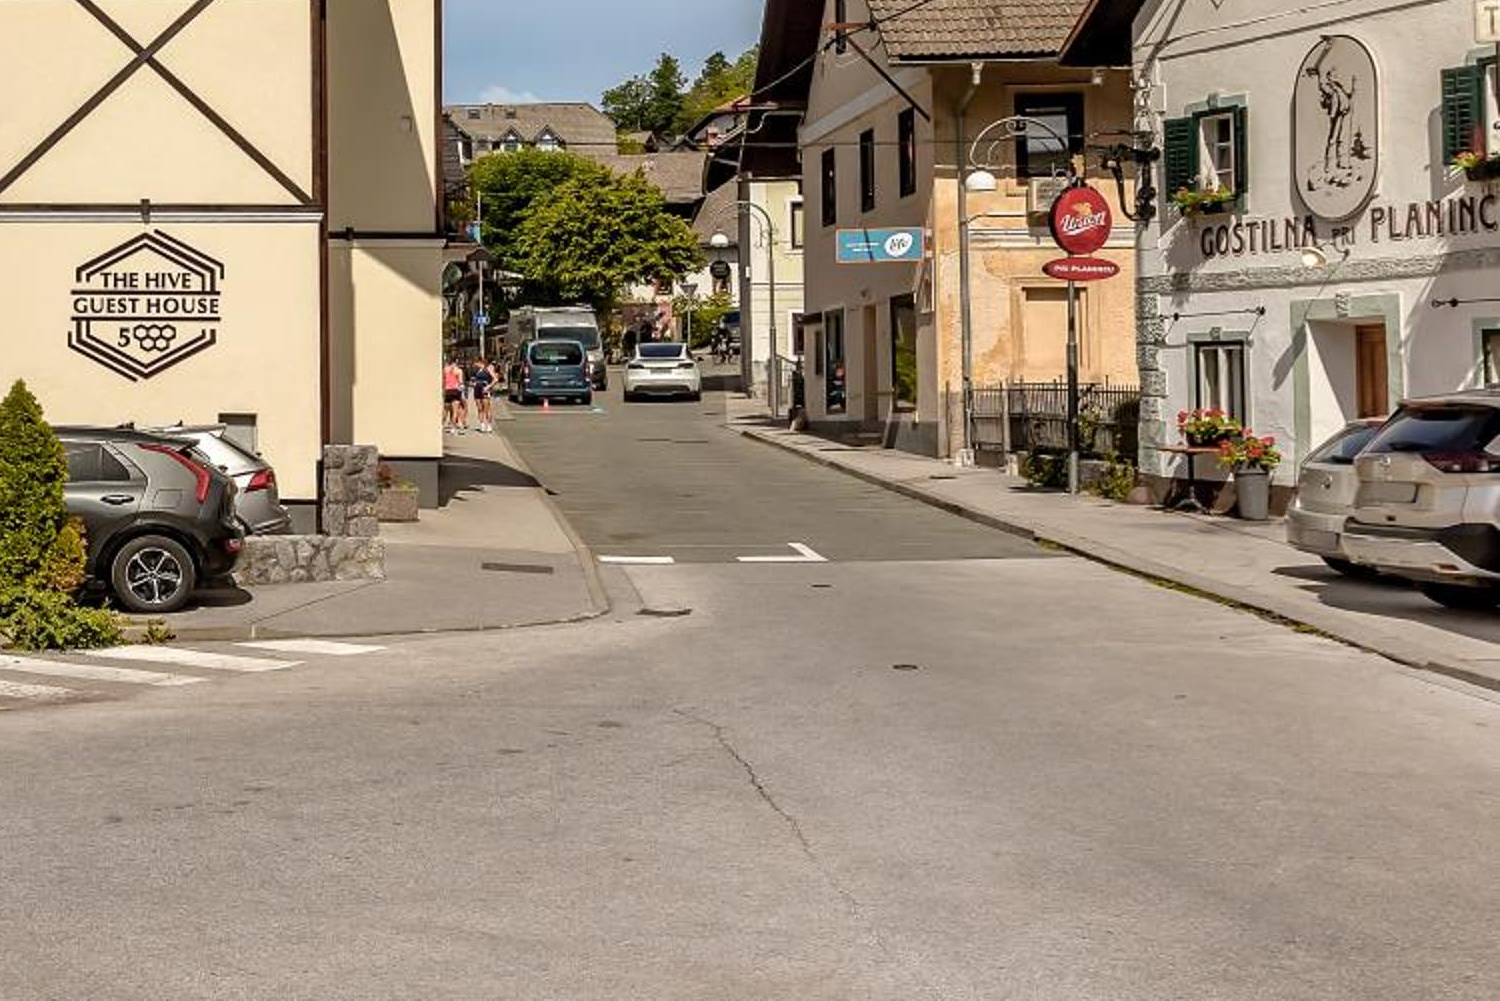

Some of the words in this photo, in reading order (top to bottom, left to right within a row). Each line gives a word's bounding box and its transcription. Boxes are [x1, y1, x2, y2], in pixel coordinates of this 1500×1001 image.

[1201, 215, 1318, 258] GOSTILNA
[1331, 225, 1356, 247] PRI
[1370, 193, 1499, 244] PLANINC
[100, 272, 139, 289] THE
[145, 272, 192, 289] HIVE
[73, 297, 140, 314] GUEST
[146, 297, 220, 314] HOUSE
[117, 327, 131, 348] 5
